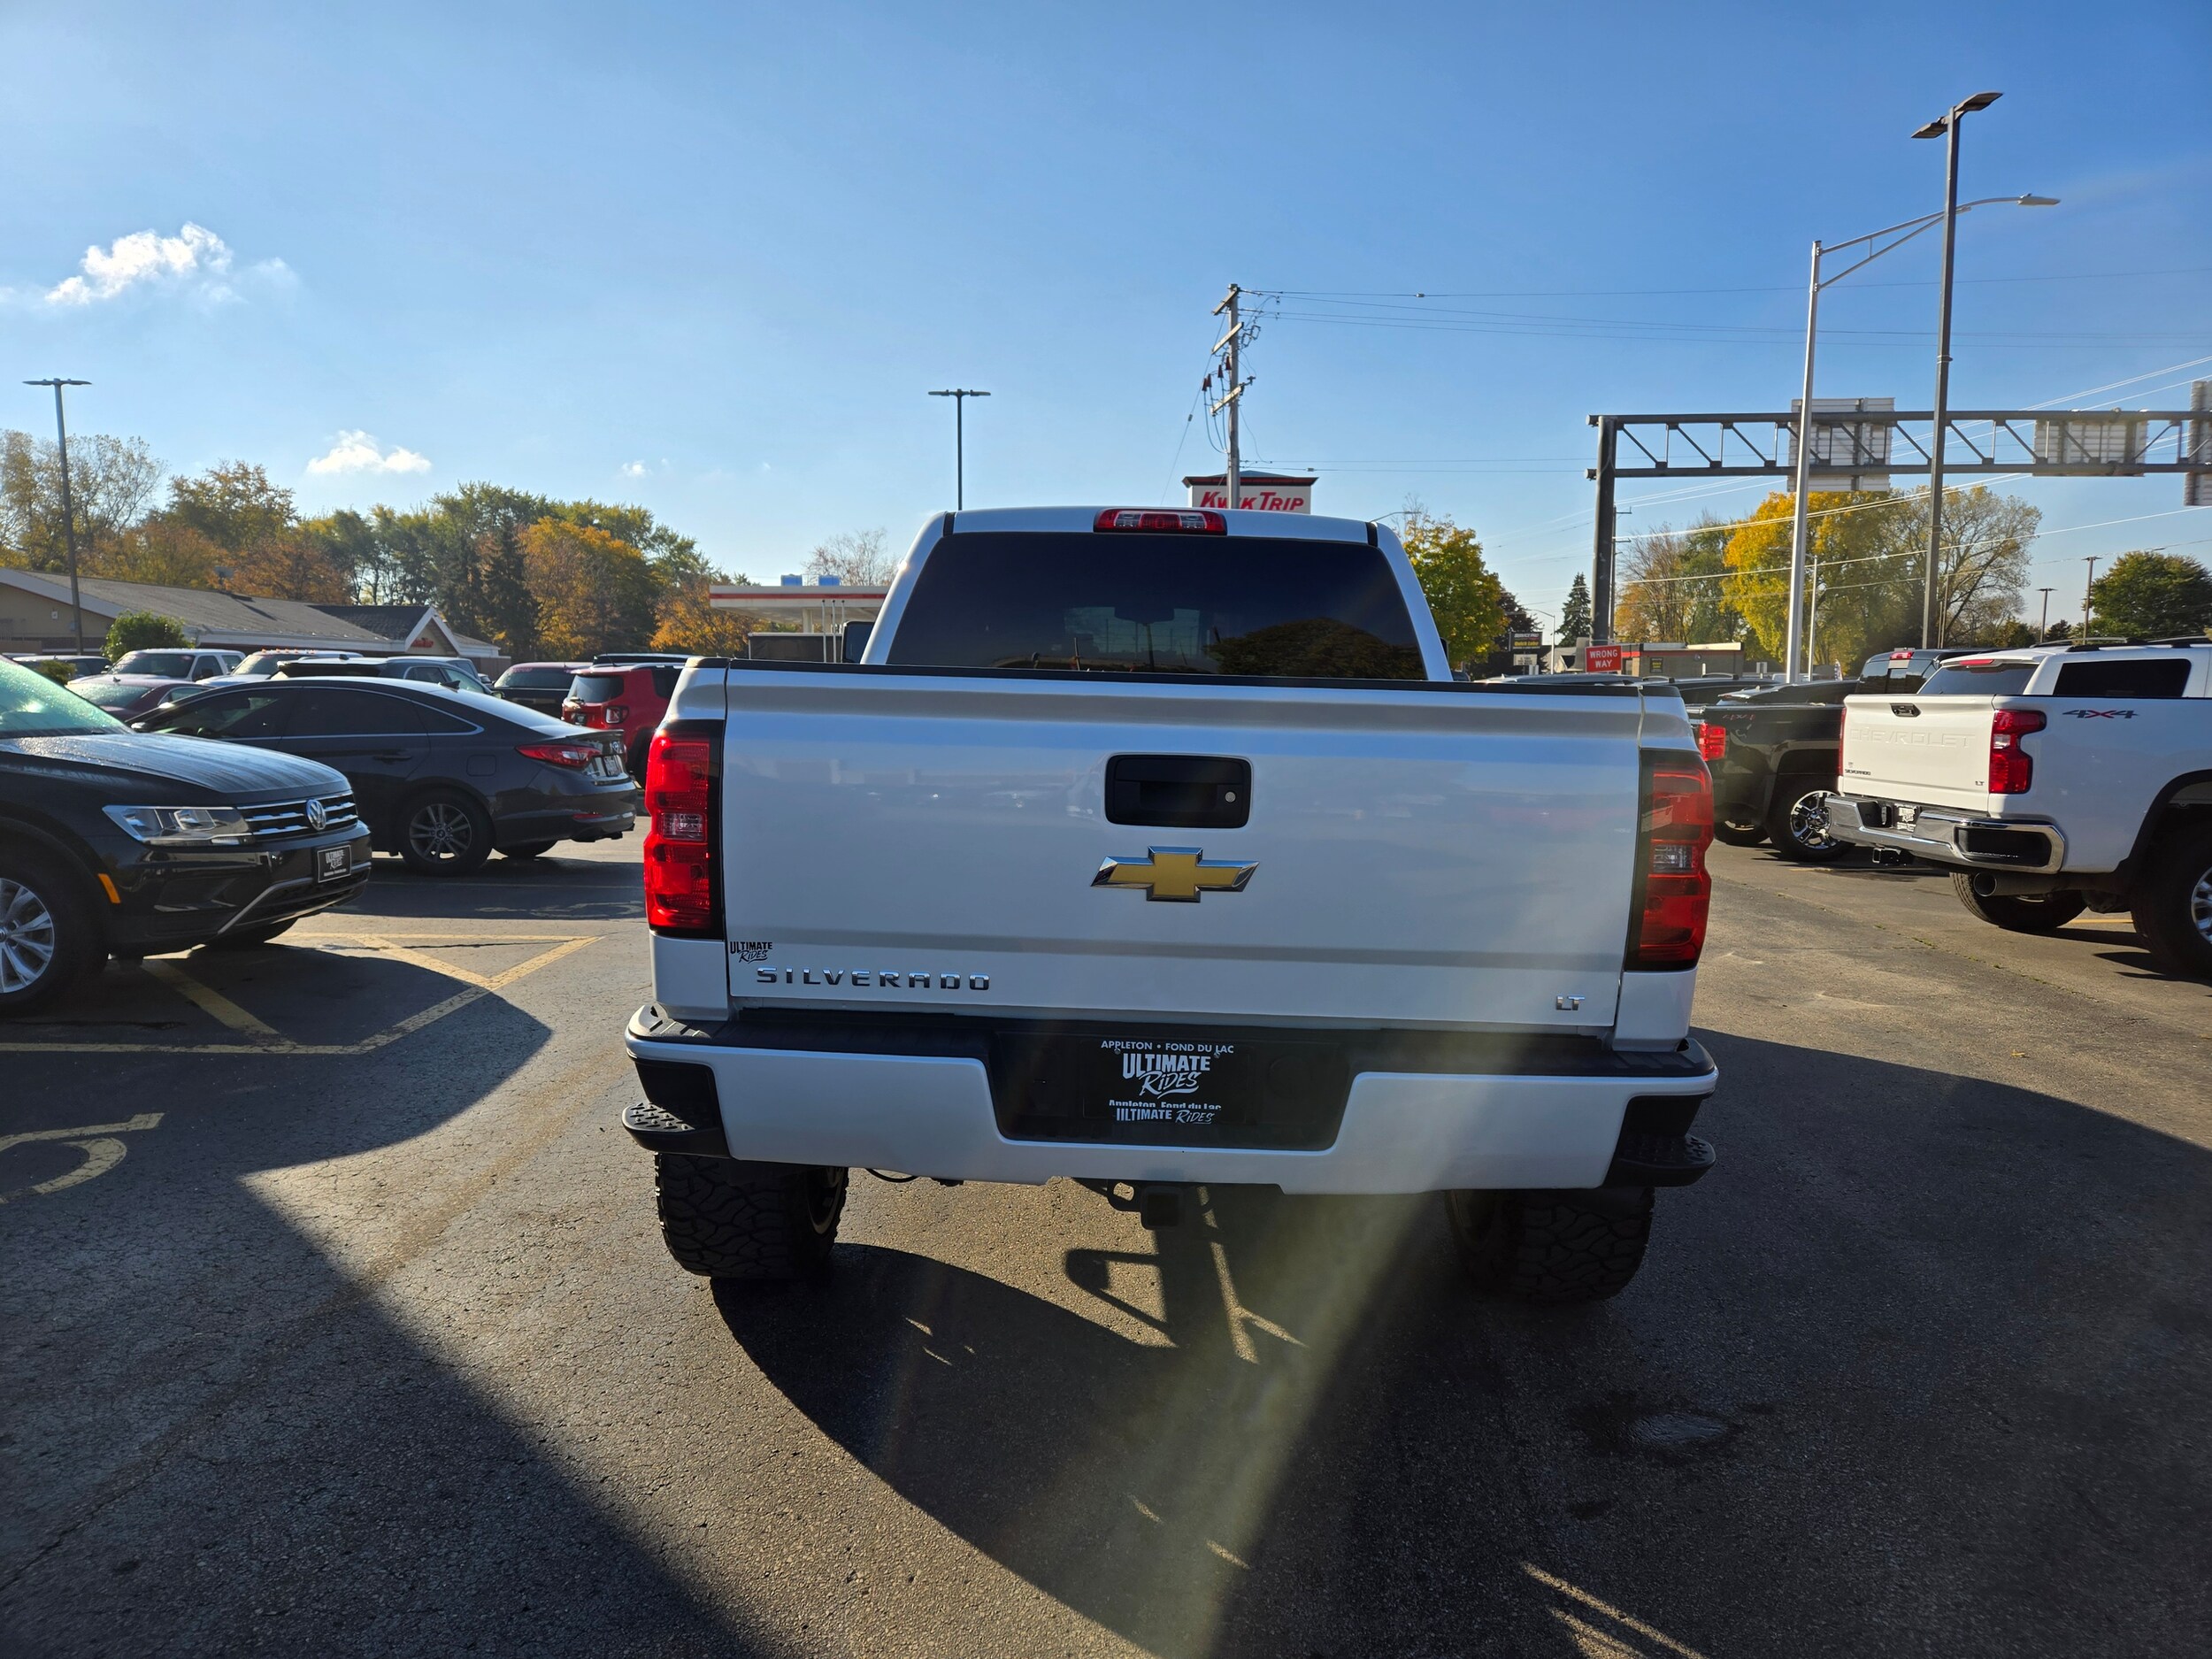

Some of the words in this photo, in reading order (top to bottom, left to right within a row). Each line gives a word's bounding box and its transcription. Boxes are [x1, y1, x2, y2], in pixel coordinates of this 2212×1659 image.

[1200, 491, 1257, 509] KWK
[1260, 492, 1304, 511] TRIP
[1589, 649, 1618, 659] WRONG
[1594, 659, 1613, 668] WAY
[1849, 728, 1975, 749] CHEVROLET
[730, 941, 773, 955] ULTIMATE
[757, 967, 990, 991] SILVERADO
[1555, 995, 1586, 1011] LT
[1101, 1041, 1153, 1050] APPLETON
[1165, 1043, 1194, 1052] FOND
[1215, 1044, 1234, 1055] LAC
[1122, 1053, 1211, 1079] ULTIMATE
[1116, 1108, 1172, 1122] ULTIMATE
